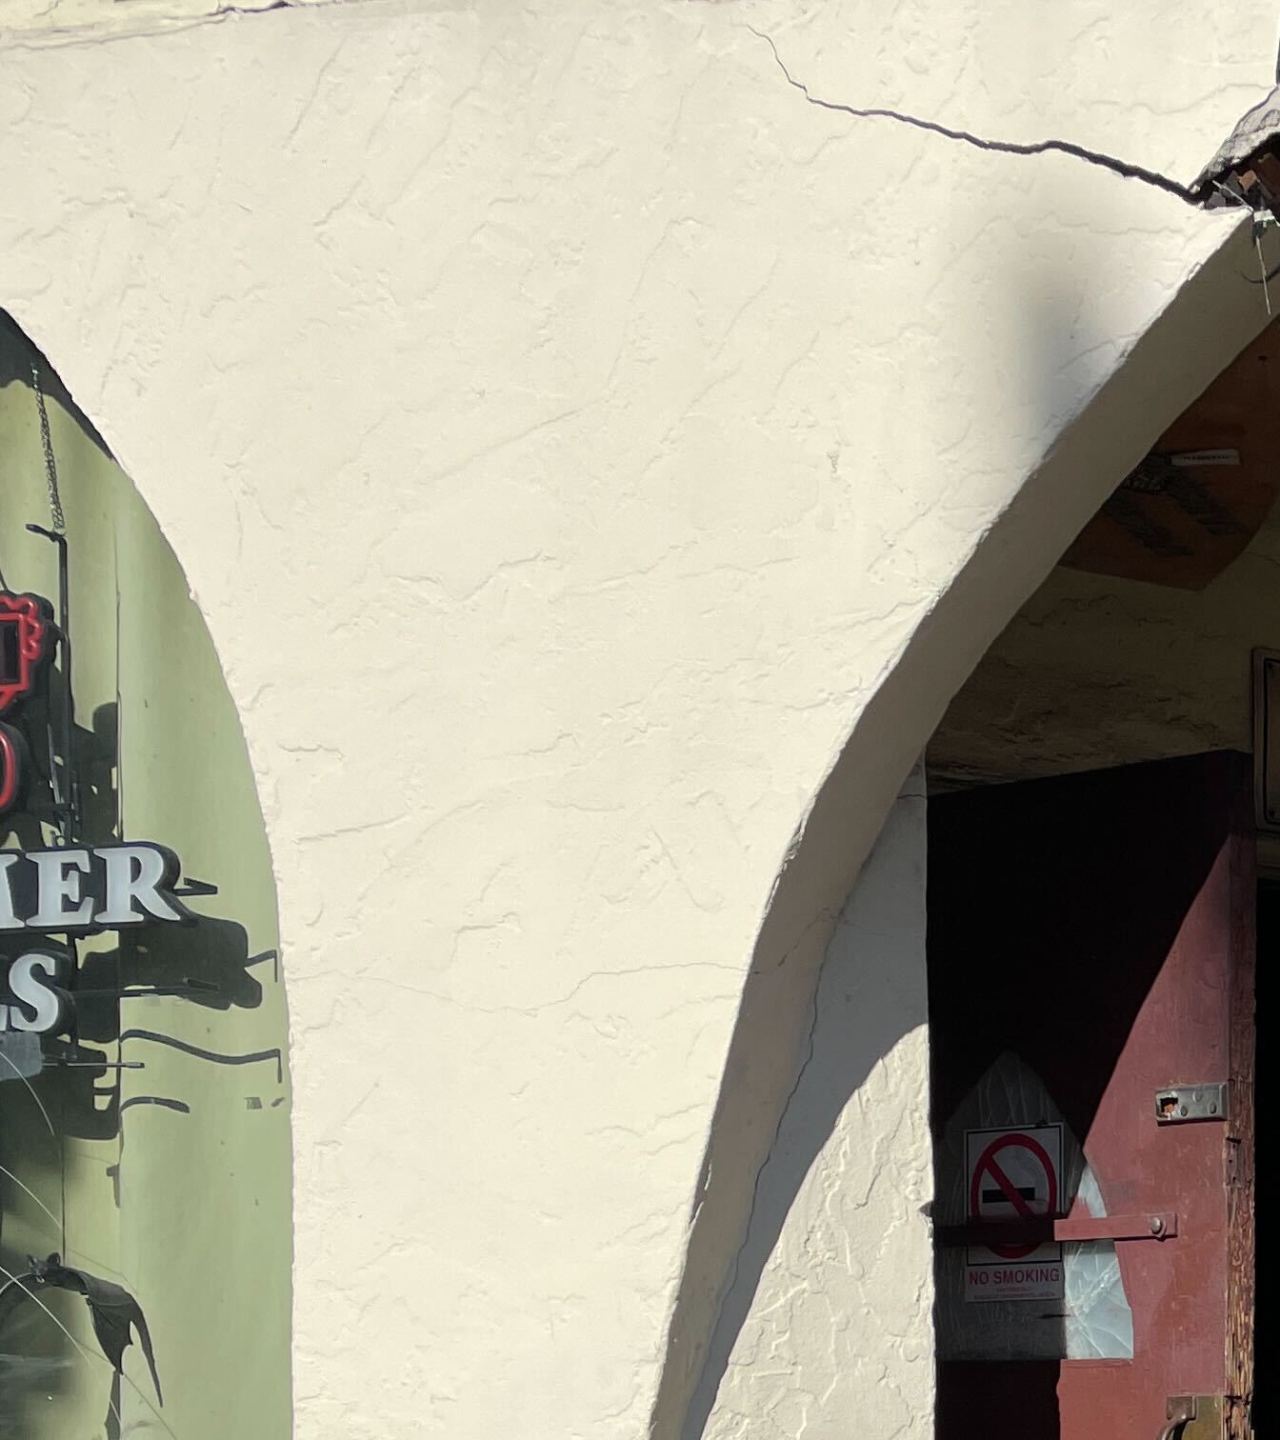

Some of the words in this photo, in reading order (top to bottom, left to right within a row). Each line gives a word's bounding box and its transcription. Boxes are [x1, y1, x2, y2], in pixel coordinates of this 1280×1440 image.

[0, 953, 58, 1032] S
[969, 1271, 989, 1285] NO
[993, 1268, 1060, 1284] SMOKING
